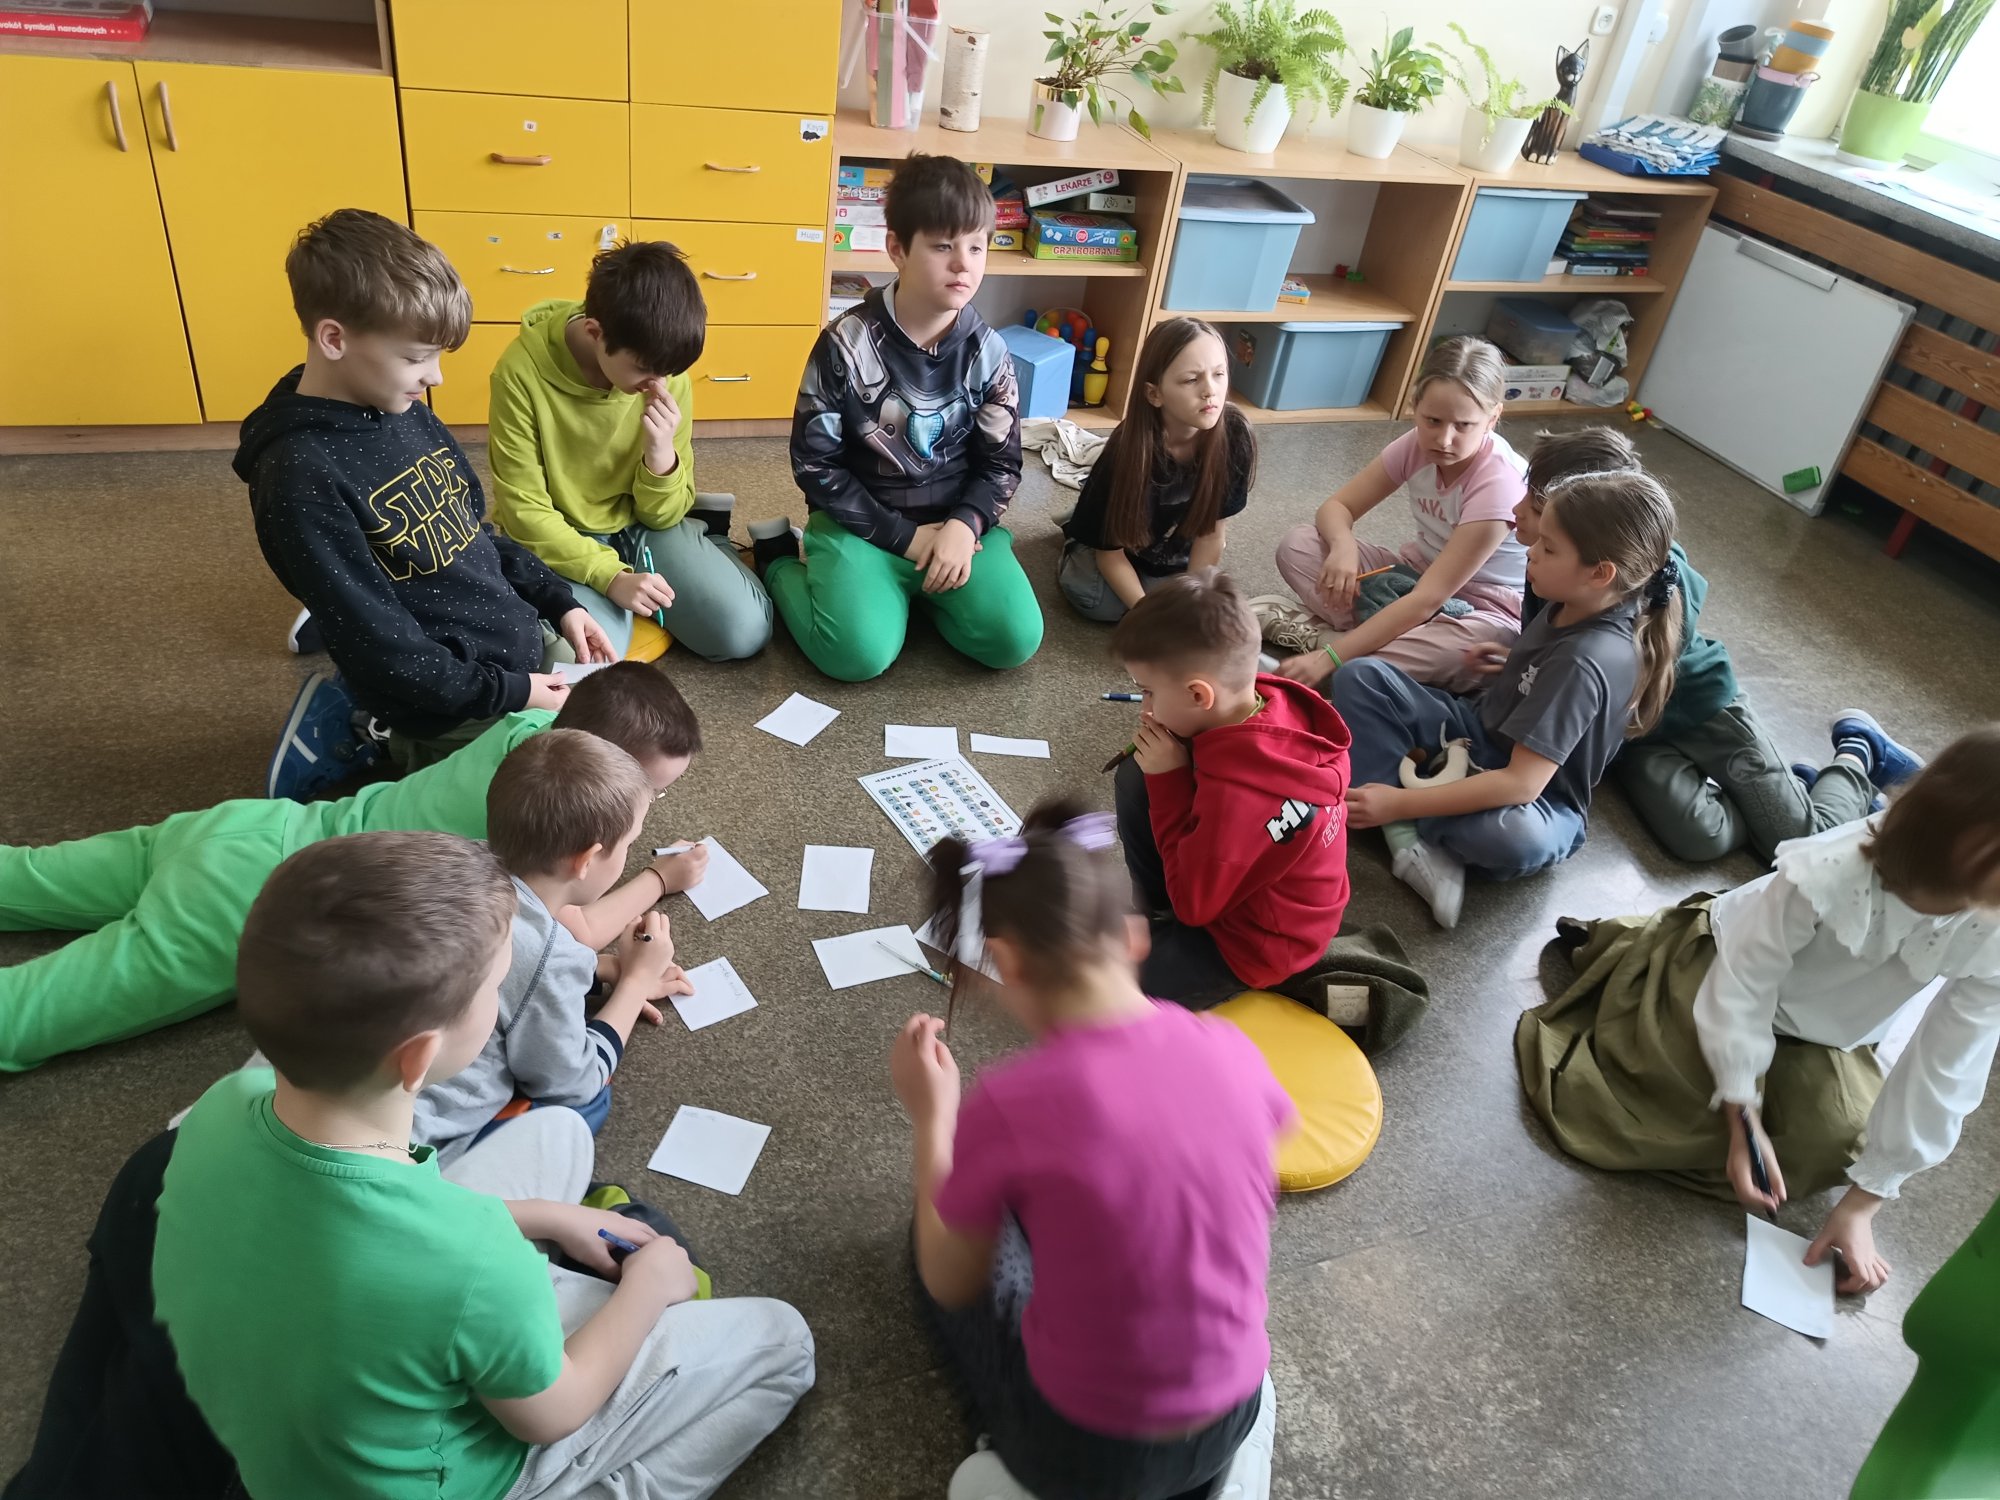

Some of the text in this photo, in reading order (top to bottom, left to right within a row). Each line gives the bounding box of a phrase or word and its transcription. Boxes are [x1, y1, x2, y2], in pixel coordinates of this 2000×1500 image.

[24, 22, 55, 32] symboli
[57, 24, 107, 35] narodowych
[1055, 177, 1092, 193] LEKARZE
[1053, 246, 1121, 256] GRZYBOBRANIE
[363, 447, 470, 544] STAR
[1266, 799, 1312, 842] MI
